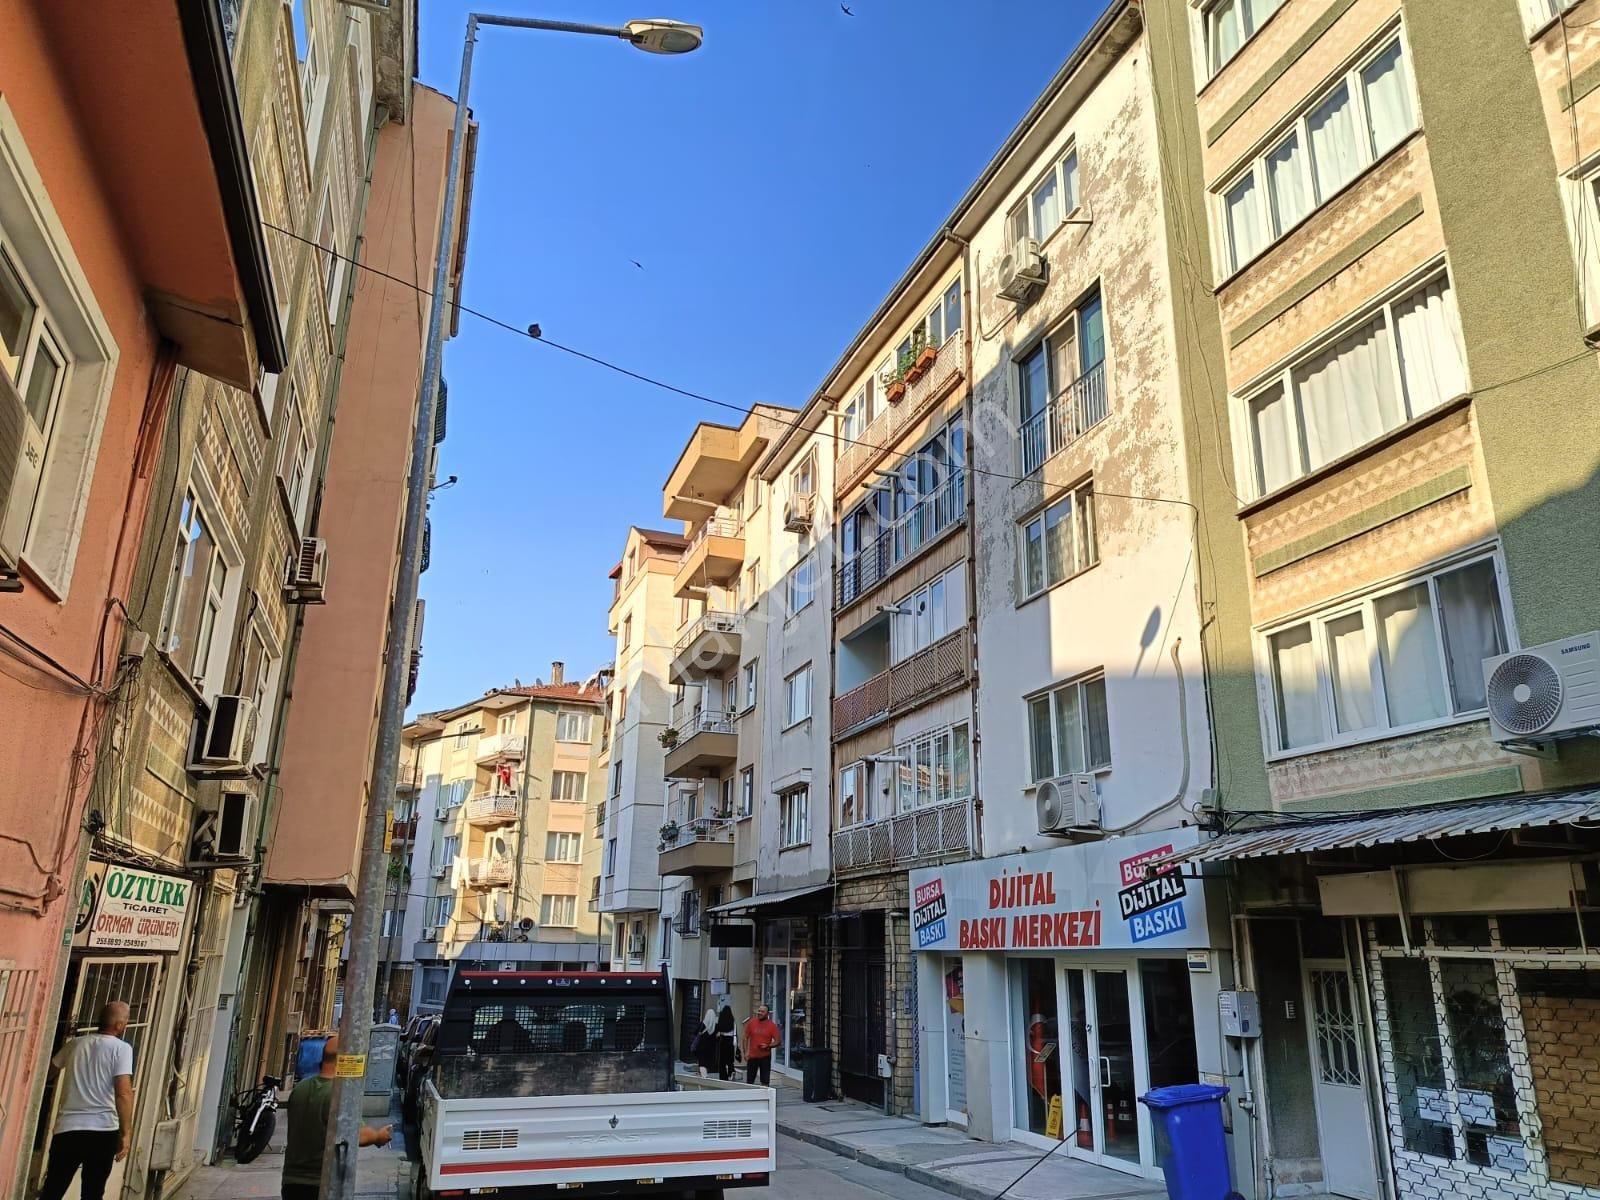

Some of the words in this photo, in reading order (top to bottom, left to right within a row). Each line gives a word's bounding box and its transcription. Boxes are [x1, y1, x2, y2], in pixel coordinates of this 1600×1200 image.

[1560, 642, 1591, 655] SAMSUNG
[107, 867, 188, 907] ÖZTÜRK
[916, 882, 940, 904] BURSA
[989, 866, 1056, 910] DİJİTAL
[96, 914, 134, 934] ORMAN
[920, 922, 944, 945] BASKI
[960, 917, 1006, 949] BASKI
[1012, 899, 1101, 948] MERKEZİ
[1133, 905, 1182, 939] BASKI
